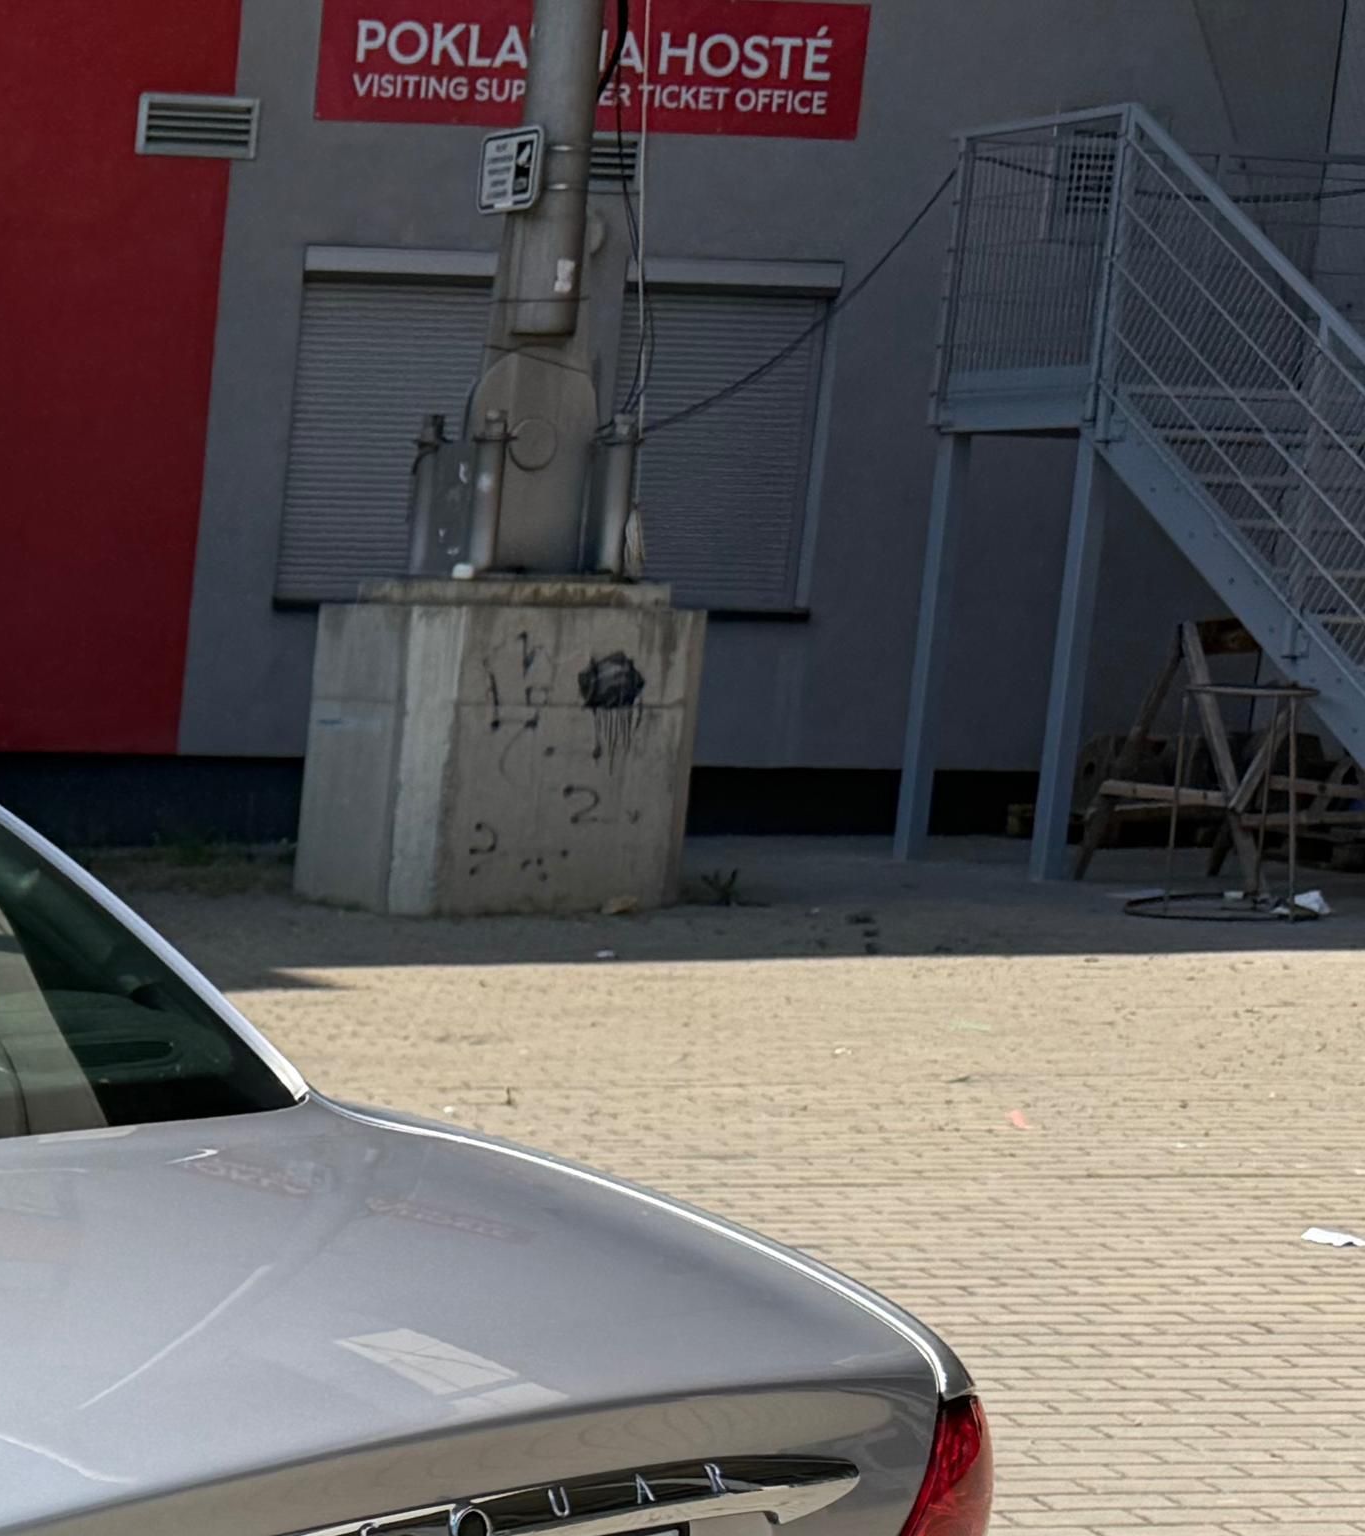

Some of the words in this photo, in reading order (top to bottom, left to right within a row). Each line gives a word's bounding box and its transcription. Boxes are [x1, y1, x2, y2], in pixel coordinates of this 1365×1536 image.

[356, 19, 646, 73] POKLAA
[659, 26, 832, 81] HOSTÉ
[353, 73, 468, 101] VISITING
[475, 79, 631, 107] SUPER
[639, 83, 730, 110] TICKET
[735, 88, 827, 115] OFFICE
